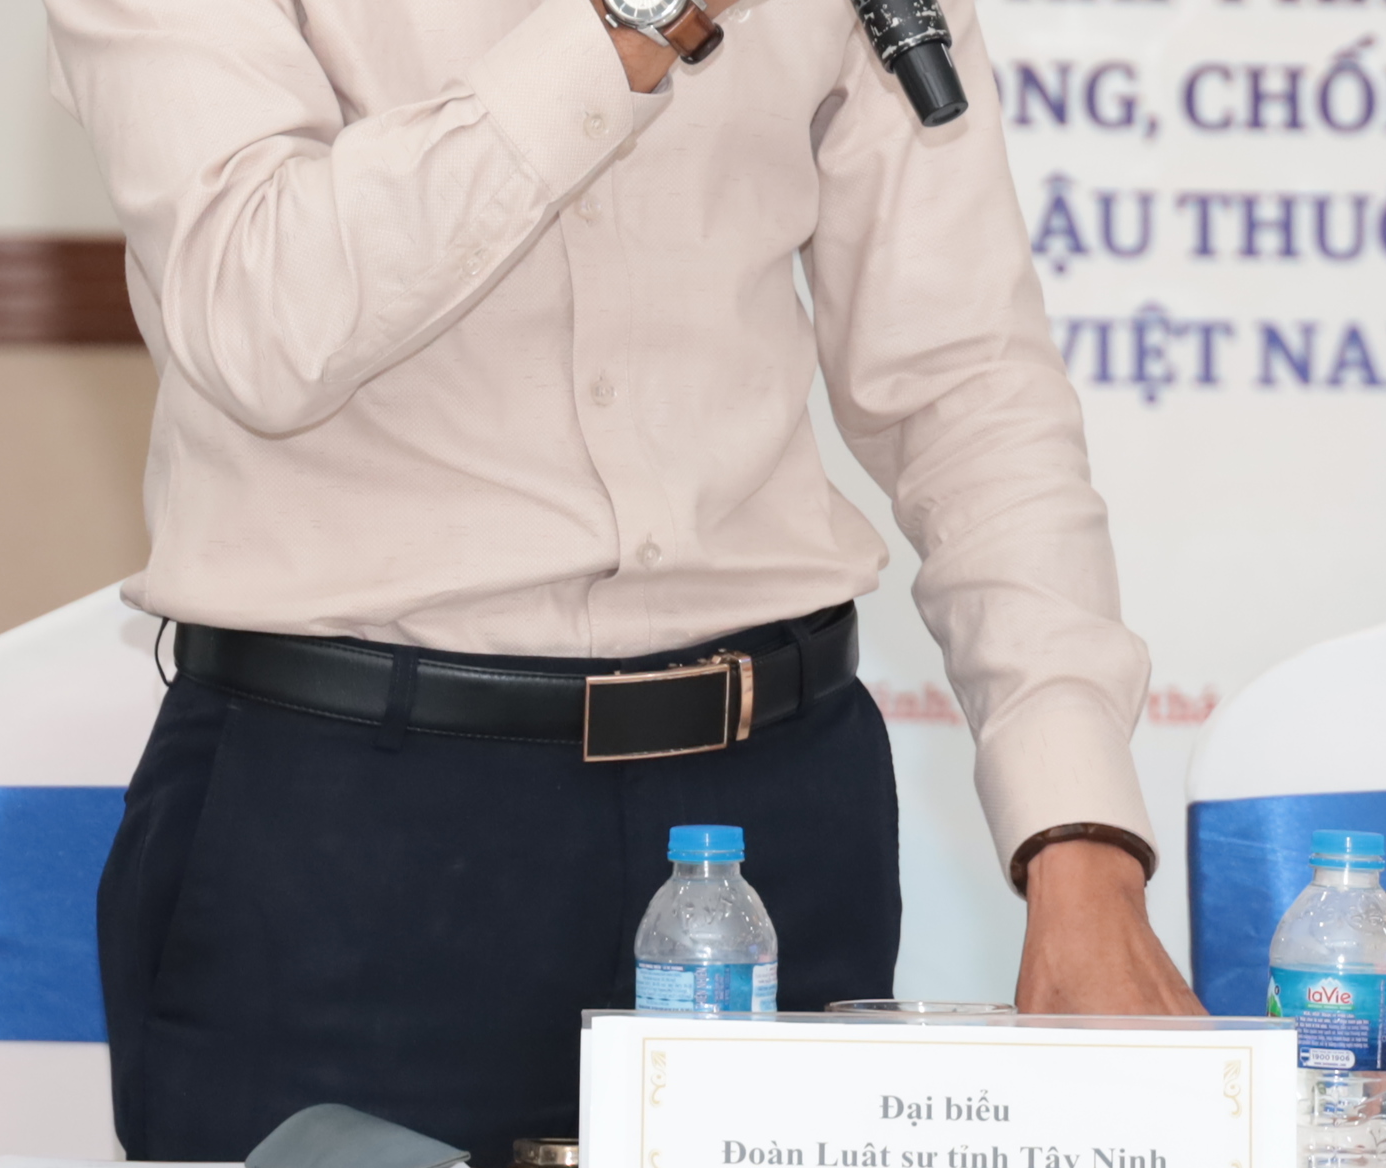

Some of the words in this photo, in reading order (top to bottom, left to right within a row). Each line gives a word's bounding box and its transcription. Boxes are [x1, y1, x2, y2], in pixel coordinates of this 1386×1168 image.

[993, 59, 1161, 140] NG,
[1030, 172, 1154, 276] ẬU
[1312, 1053, 1331, 1061] 1900
[1332, 1054, 1350, 1062] 1906
[879, 1094, 933, 1127] Đại
[945, 1089, 1010, 1122] biểu
[721, 1139, 804, 1166] Đoàn
[901, 1148, 938, 1168] sư
[947, 1144, 1008, 1168] tỉnh
[1020, 1145, 1080, 1168] Tây
[1091, 1147, 1167, 1168] Ninh
